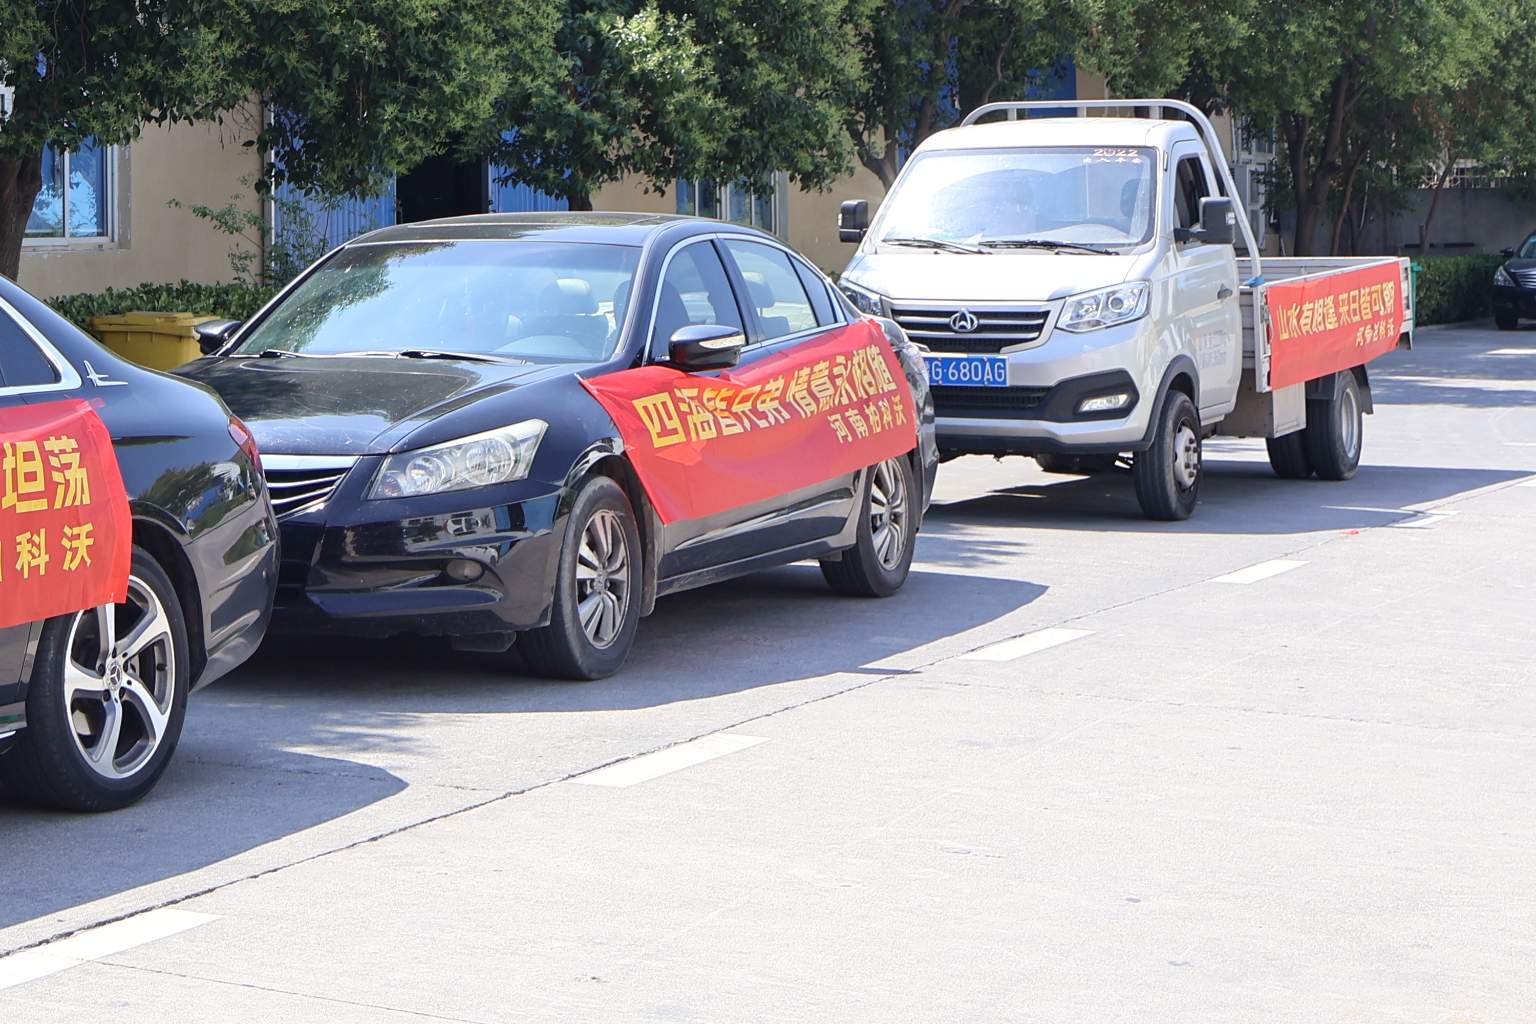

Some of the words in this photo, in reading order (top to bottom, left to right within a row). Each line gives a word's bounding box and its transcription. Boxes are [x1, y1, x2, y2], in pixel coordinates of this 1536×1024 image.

[925, 360, 1005, 382] G·680AG
[632, 375, 791, 449] 四海皆兄弟
[786, 345, 897, 419] 情意永相随
[827, 394, 907, 444] 河南柏科沃
